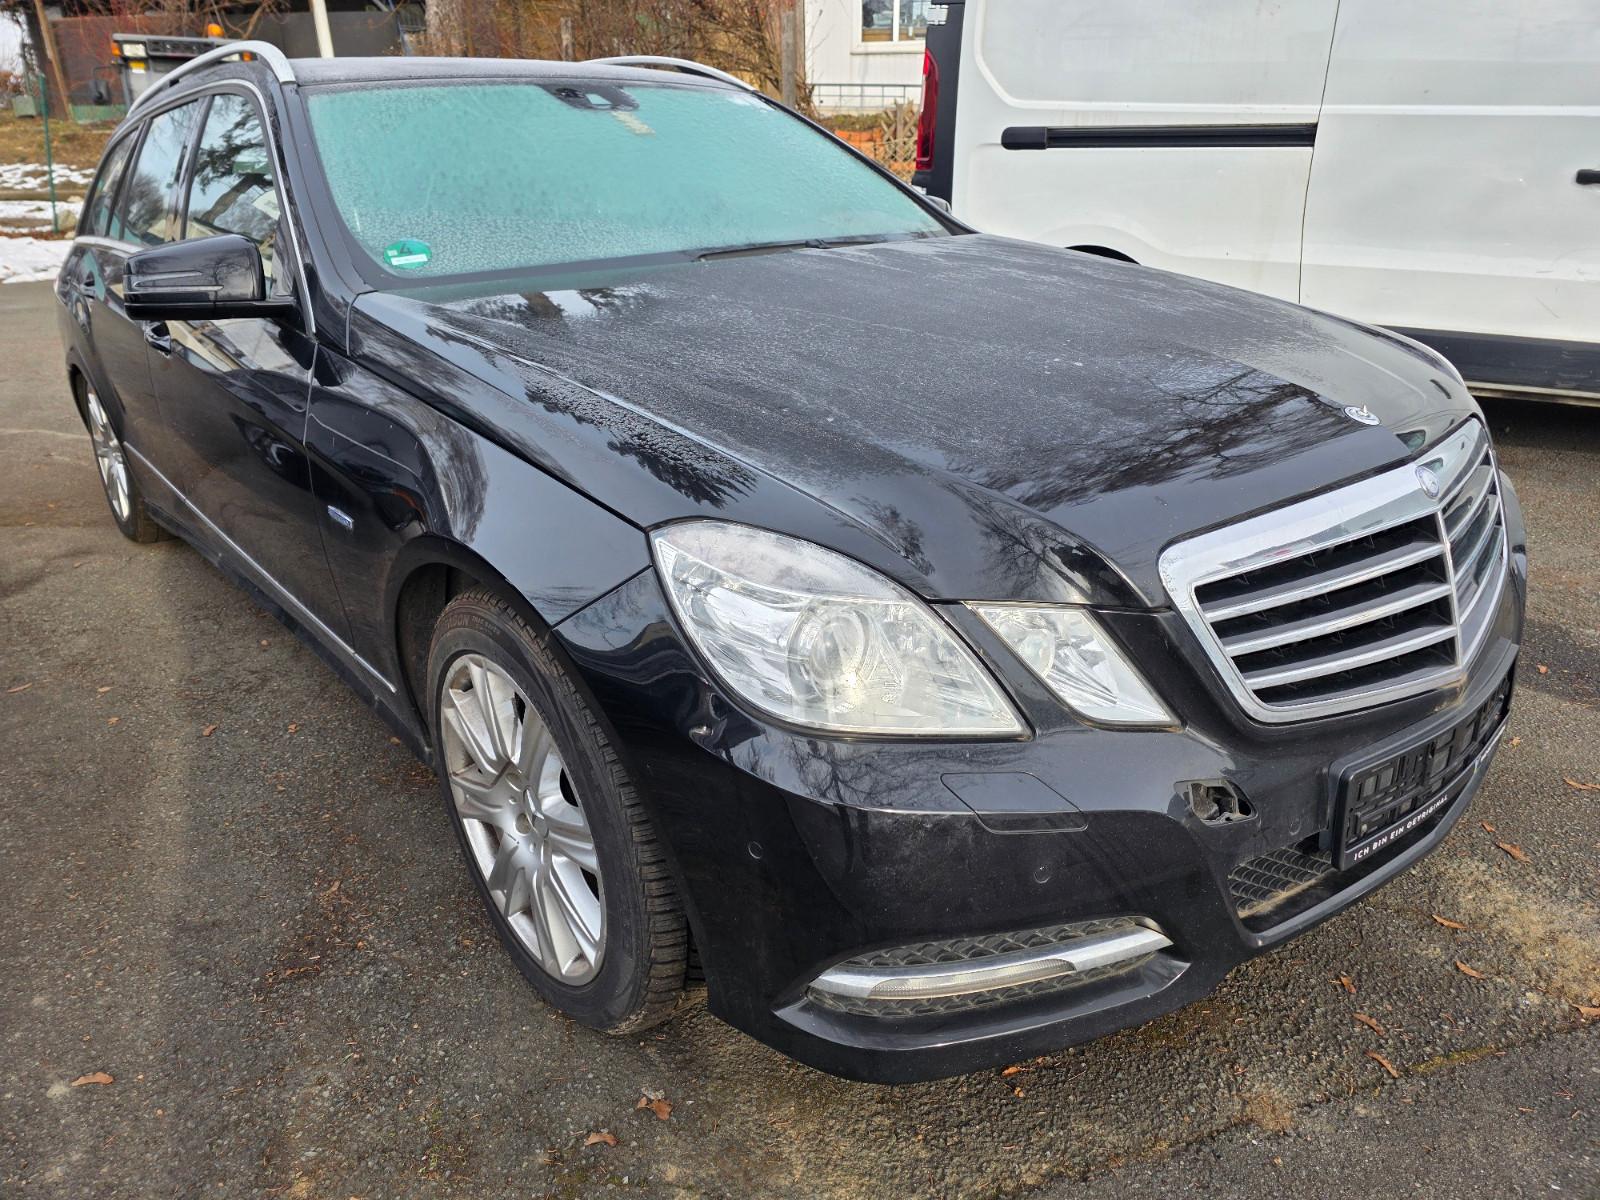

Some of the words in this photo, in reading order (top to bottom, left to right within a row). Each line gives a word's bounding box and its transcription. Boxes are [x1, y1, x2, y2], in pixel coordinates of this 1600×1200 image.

[1354, 846, 1369, 861] ICH
[1372, 836, 1387, 850] BIN
[1390, 826, 1405, 839] EIN
